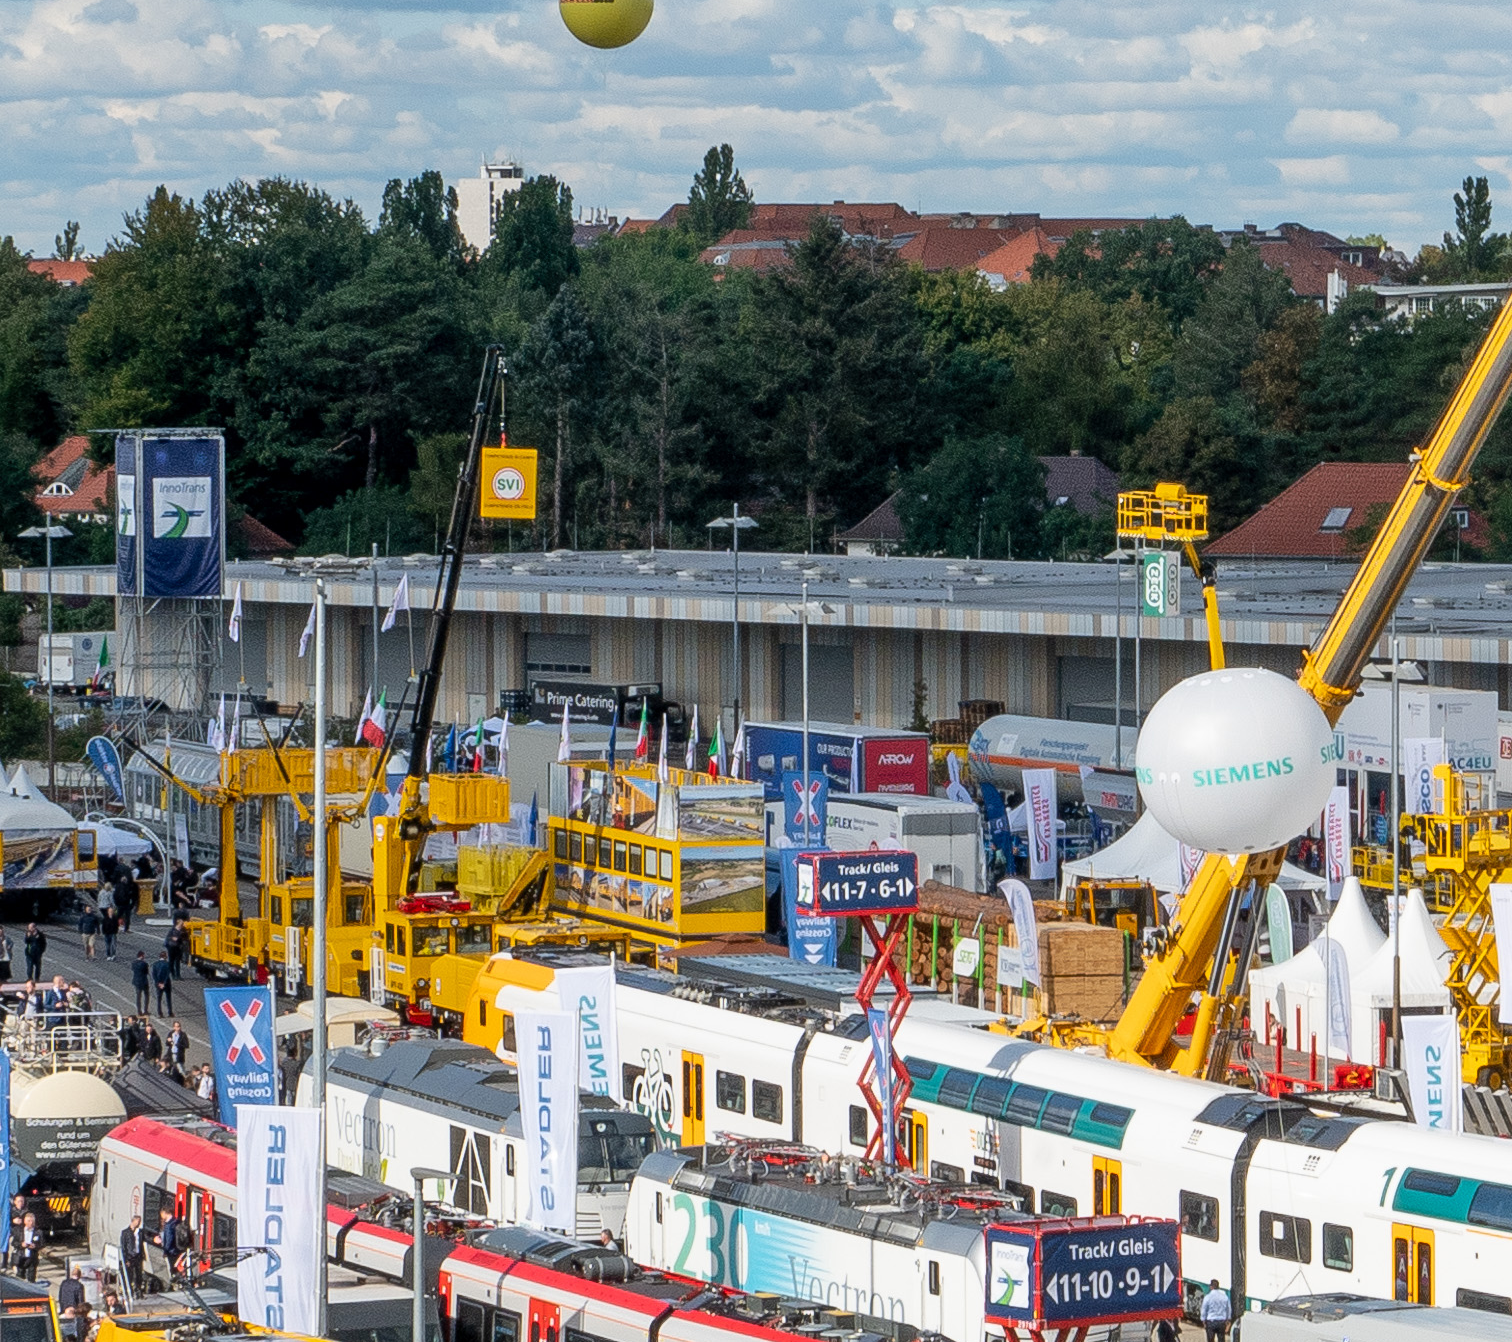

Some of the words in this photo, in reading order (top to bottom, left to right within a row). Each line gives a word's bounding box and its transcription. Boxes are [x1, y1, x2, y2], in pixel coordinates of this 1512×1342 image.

[159, 481, 206, 495] InnoTrans
[497, 478, 521, 491] SVI
[547, 691, 574, 707] Prime
[576, 693, 615, 712] Catering
[1192, 756, 1294, 787] SIEMENS
[873, 861, 900, 875] Gleis
[831, 881, 867, 902] 11-7
[879, 880, 905, 899] 6-1
[26, 1118, 73, 1129] Schulungen
[84, 1116, 120, 1126] Seminare
[336, 1095, 398, 1159] Vectron
[1380, 1167, 1398, 1208] 1
[672, 1192, 751, 1293] 230
[1069, 1241, 1115, 1260] Track/
[1117, 1239, 1155, 1258] Gleis
[787, 1254, 907, 1326] Vectron
[1059, 1273, 1113, 1301] 11-10
